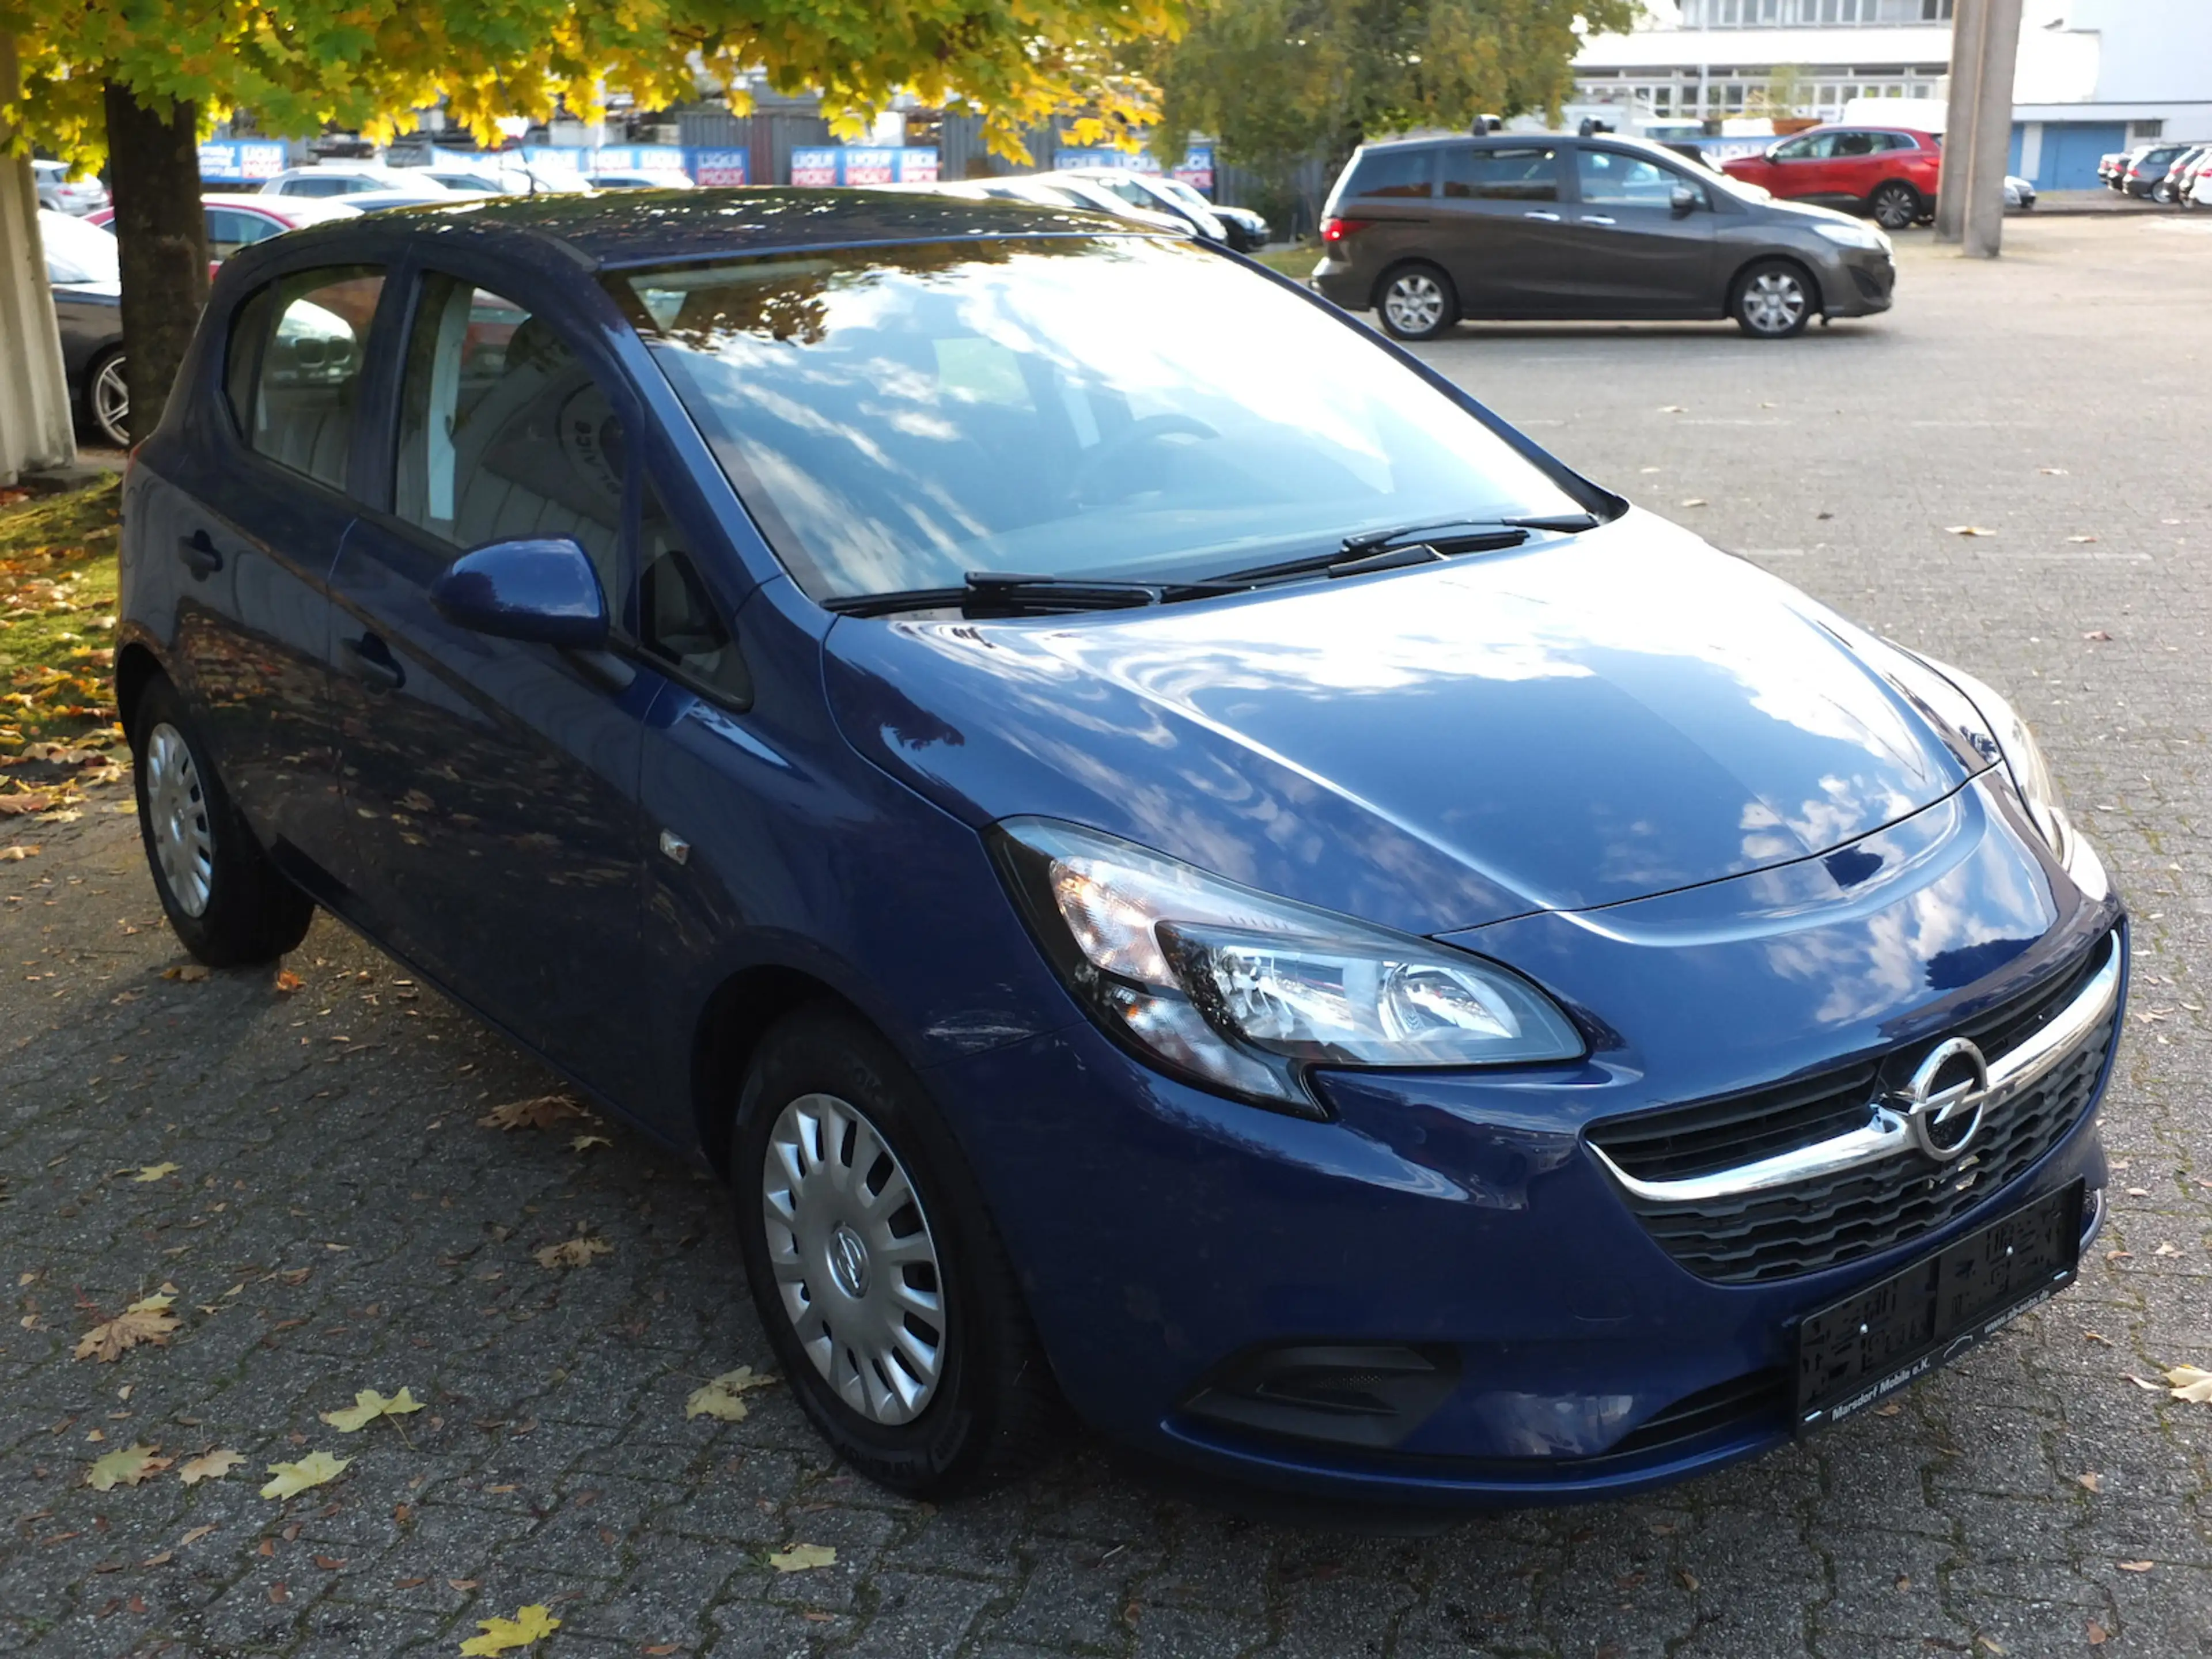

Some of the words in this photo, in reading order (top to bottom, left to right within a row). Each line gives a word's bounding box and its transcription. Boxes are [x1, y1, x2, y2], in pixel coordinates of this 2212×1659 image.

[1832, 1385, 1878, 1421] Marsdorf
[1880, 1369, 1910, 1393] Mobile
[1912, 1357, 1930, 1375] e.K.
